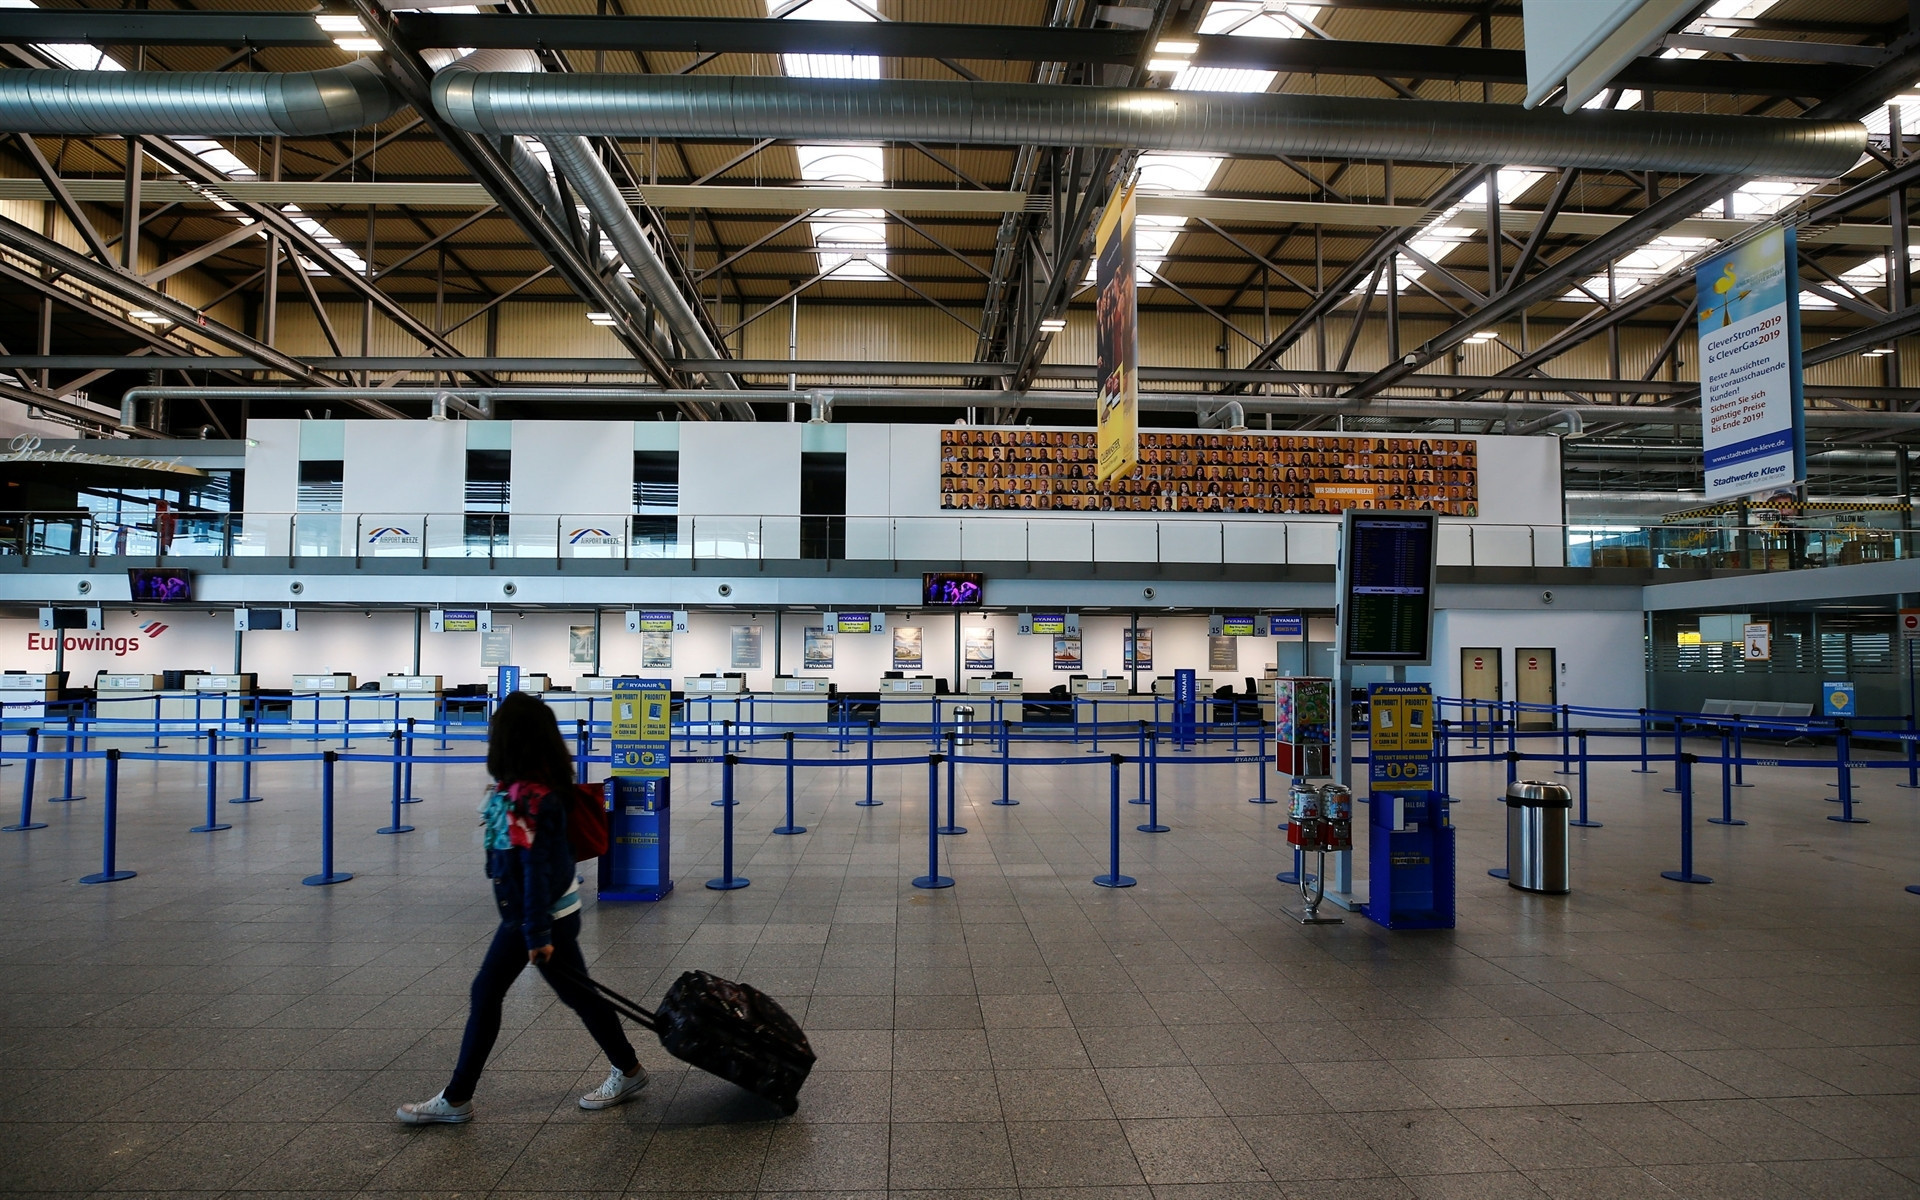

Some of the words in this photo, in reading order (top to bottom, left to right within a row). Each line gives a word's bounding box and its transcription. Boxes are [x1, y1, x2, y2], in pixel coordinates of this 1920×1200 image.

[1707, 315, 1782, 351] CleverStrom2019
[1708, 355, 1715, 364] &
[1716, 329, 1781, 361] CleverGas2019
[1709, 371, 1728, 383] Beste
[1729, 356, 1770, 376] Aussichten
[1709, 385, 1720, 393] für
[1720, 361, 1786, 389] vorausschauende
[1710, 386, 1740, 403] Kunden!
[1710, 401, 1737, 414] Sichern
[1738, 395, 1750, 405] Sie
[1751, 390, 1766, 401] sich
[1710, 409, 1742, 426] günstige
[1743, 401, 1767, 414] Preise
[1711, 425, 1722, 434] bis
[1722, 419, 1741, 430] Ende
[1742, 411, 1765, 425] 2019!
[8, 432, 184, 472] Restaurant
[1712, 440, 1786, 463] www.stadtwerke-kleve.de
[1713, 471, 1760, 487] Stadtwerke
[1761, 465, 1786, 476] Kleve
[1835, 515, 1856, 523] FOLLOW
[1857, 515, 1866, 523] ME
[44, 619, 50, 627] 3
[239, 620, 244, 628] 5
[434, 622, 440, 630] 7
[1020, 625, 1030, 633] 13
[27, 632, 140, 657] Euowings
[1405, 698, 1428, 706] PRIORITY
